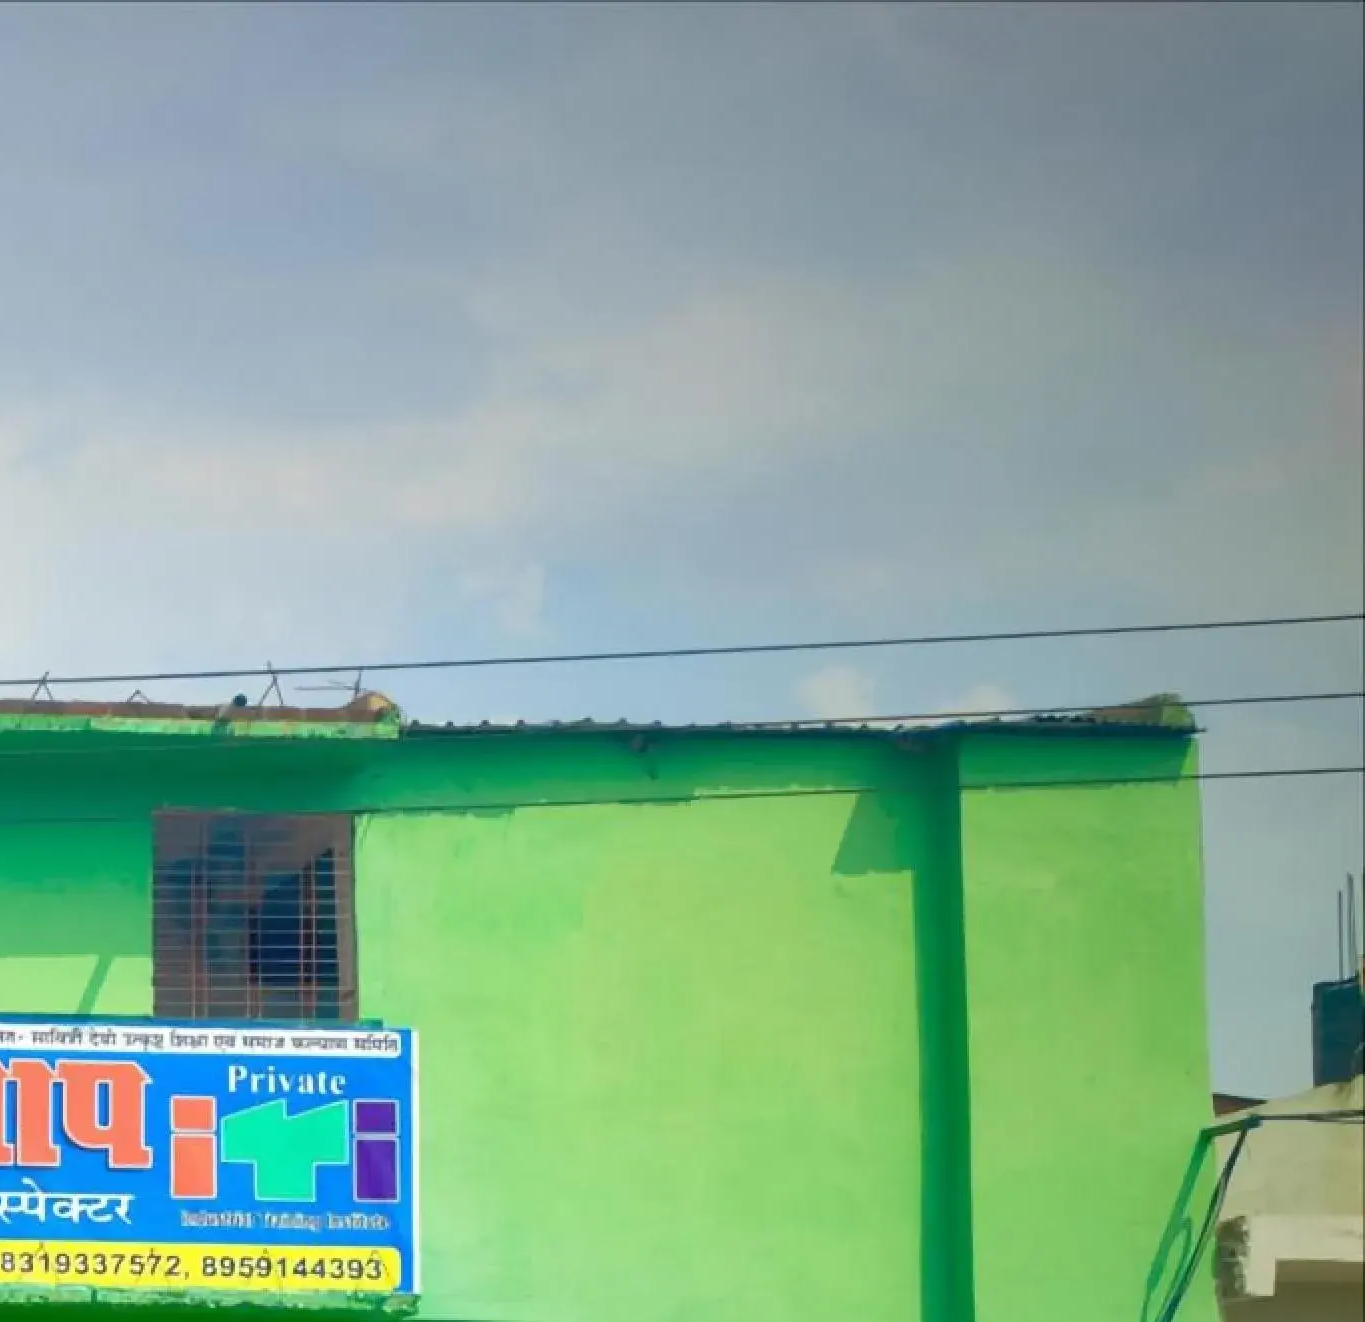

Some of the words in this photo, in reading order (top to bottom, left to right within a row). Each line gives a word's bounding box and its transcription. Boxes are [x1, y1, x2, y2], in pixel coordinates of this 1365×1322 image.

[227, 1065, 347, 1096] Private
[0, 1251, 191, 1282] 8319337572,
[202, 1254, 382, 1281] 8959144393
